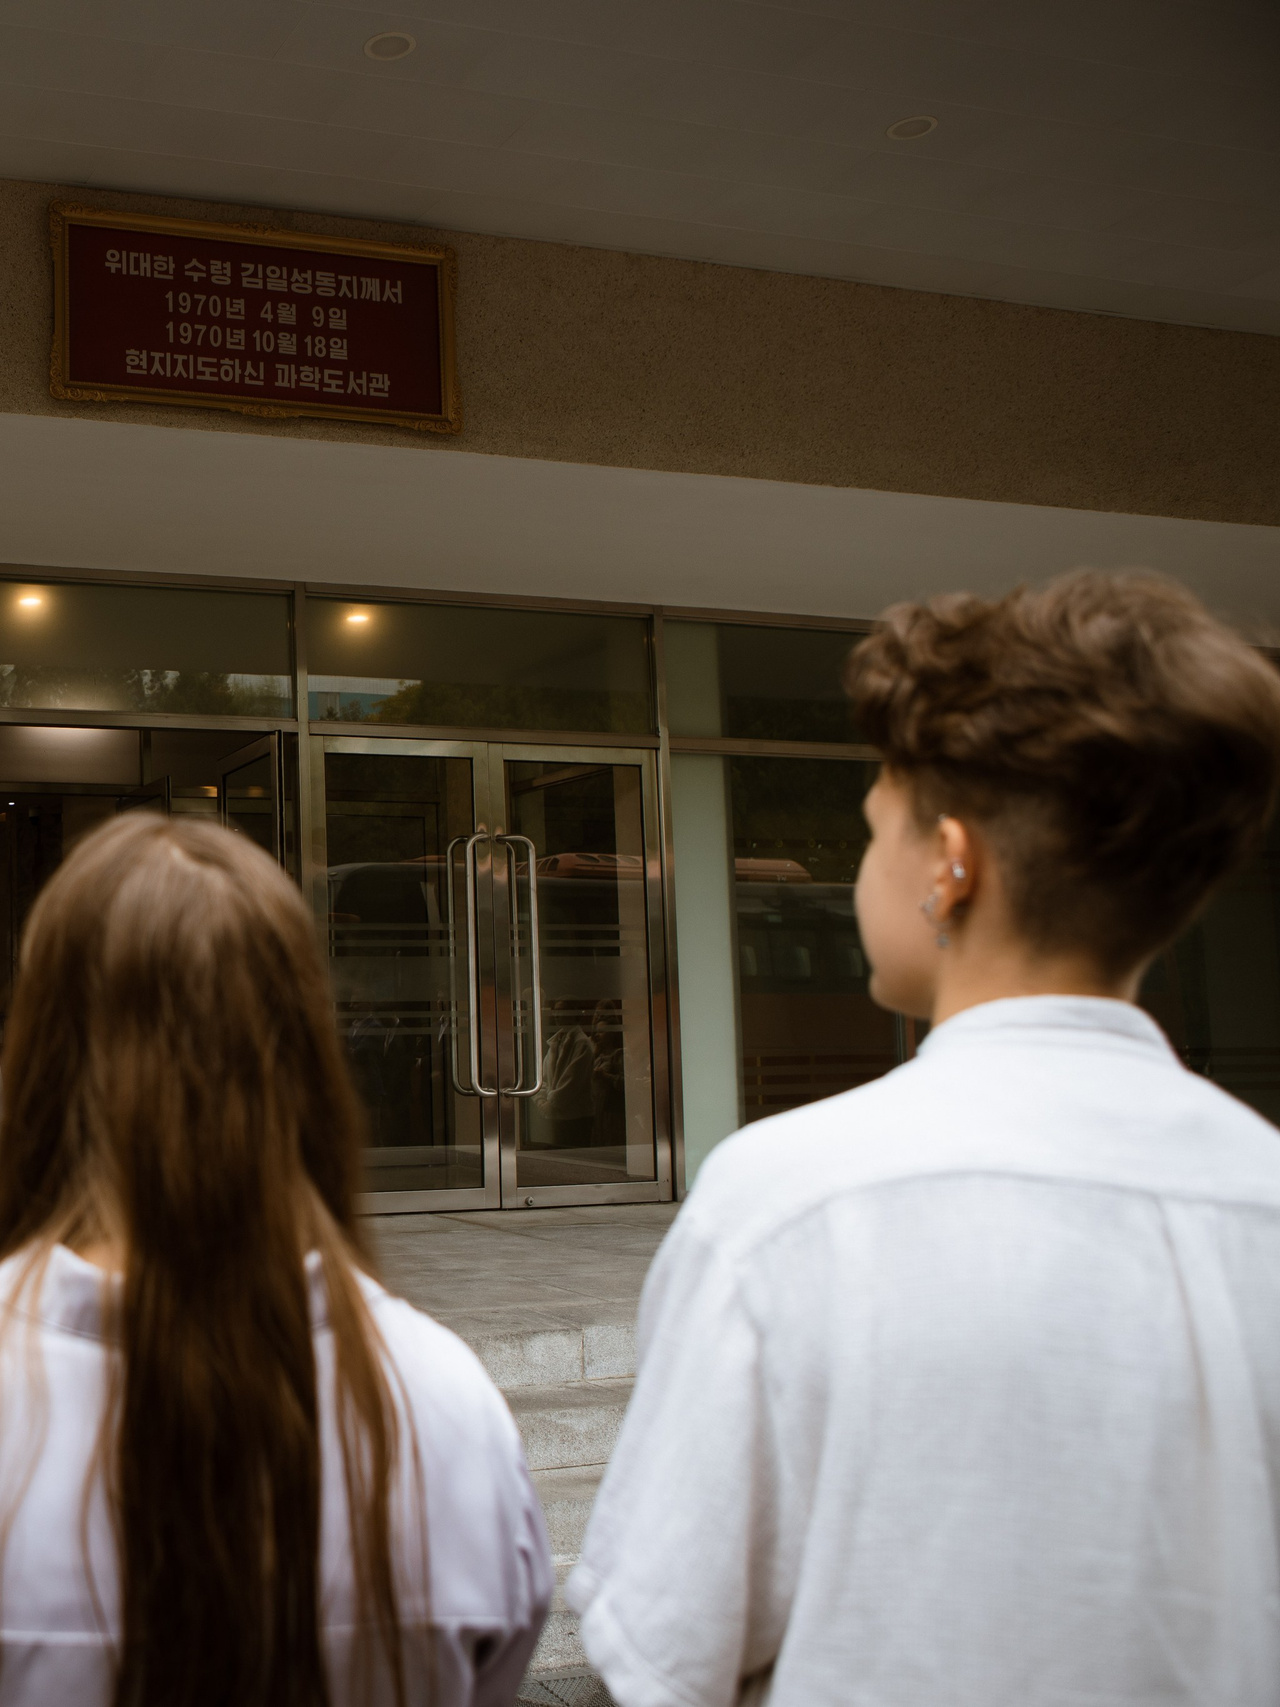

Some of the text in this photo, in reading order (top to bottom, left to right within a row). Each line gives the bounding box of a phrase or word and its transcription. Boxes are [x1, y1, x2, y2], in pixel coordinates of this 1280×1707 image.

[105, 249, 403, 304] 위대한 수령 김일성동지께서
[165, 291, 348, 331] 1970년 4월 9일
[165, 321, 348, 360] 1970년 10월 18일
[125, 349, 391, 397] 현지지도하신 과학도서관
